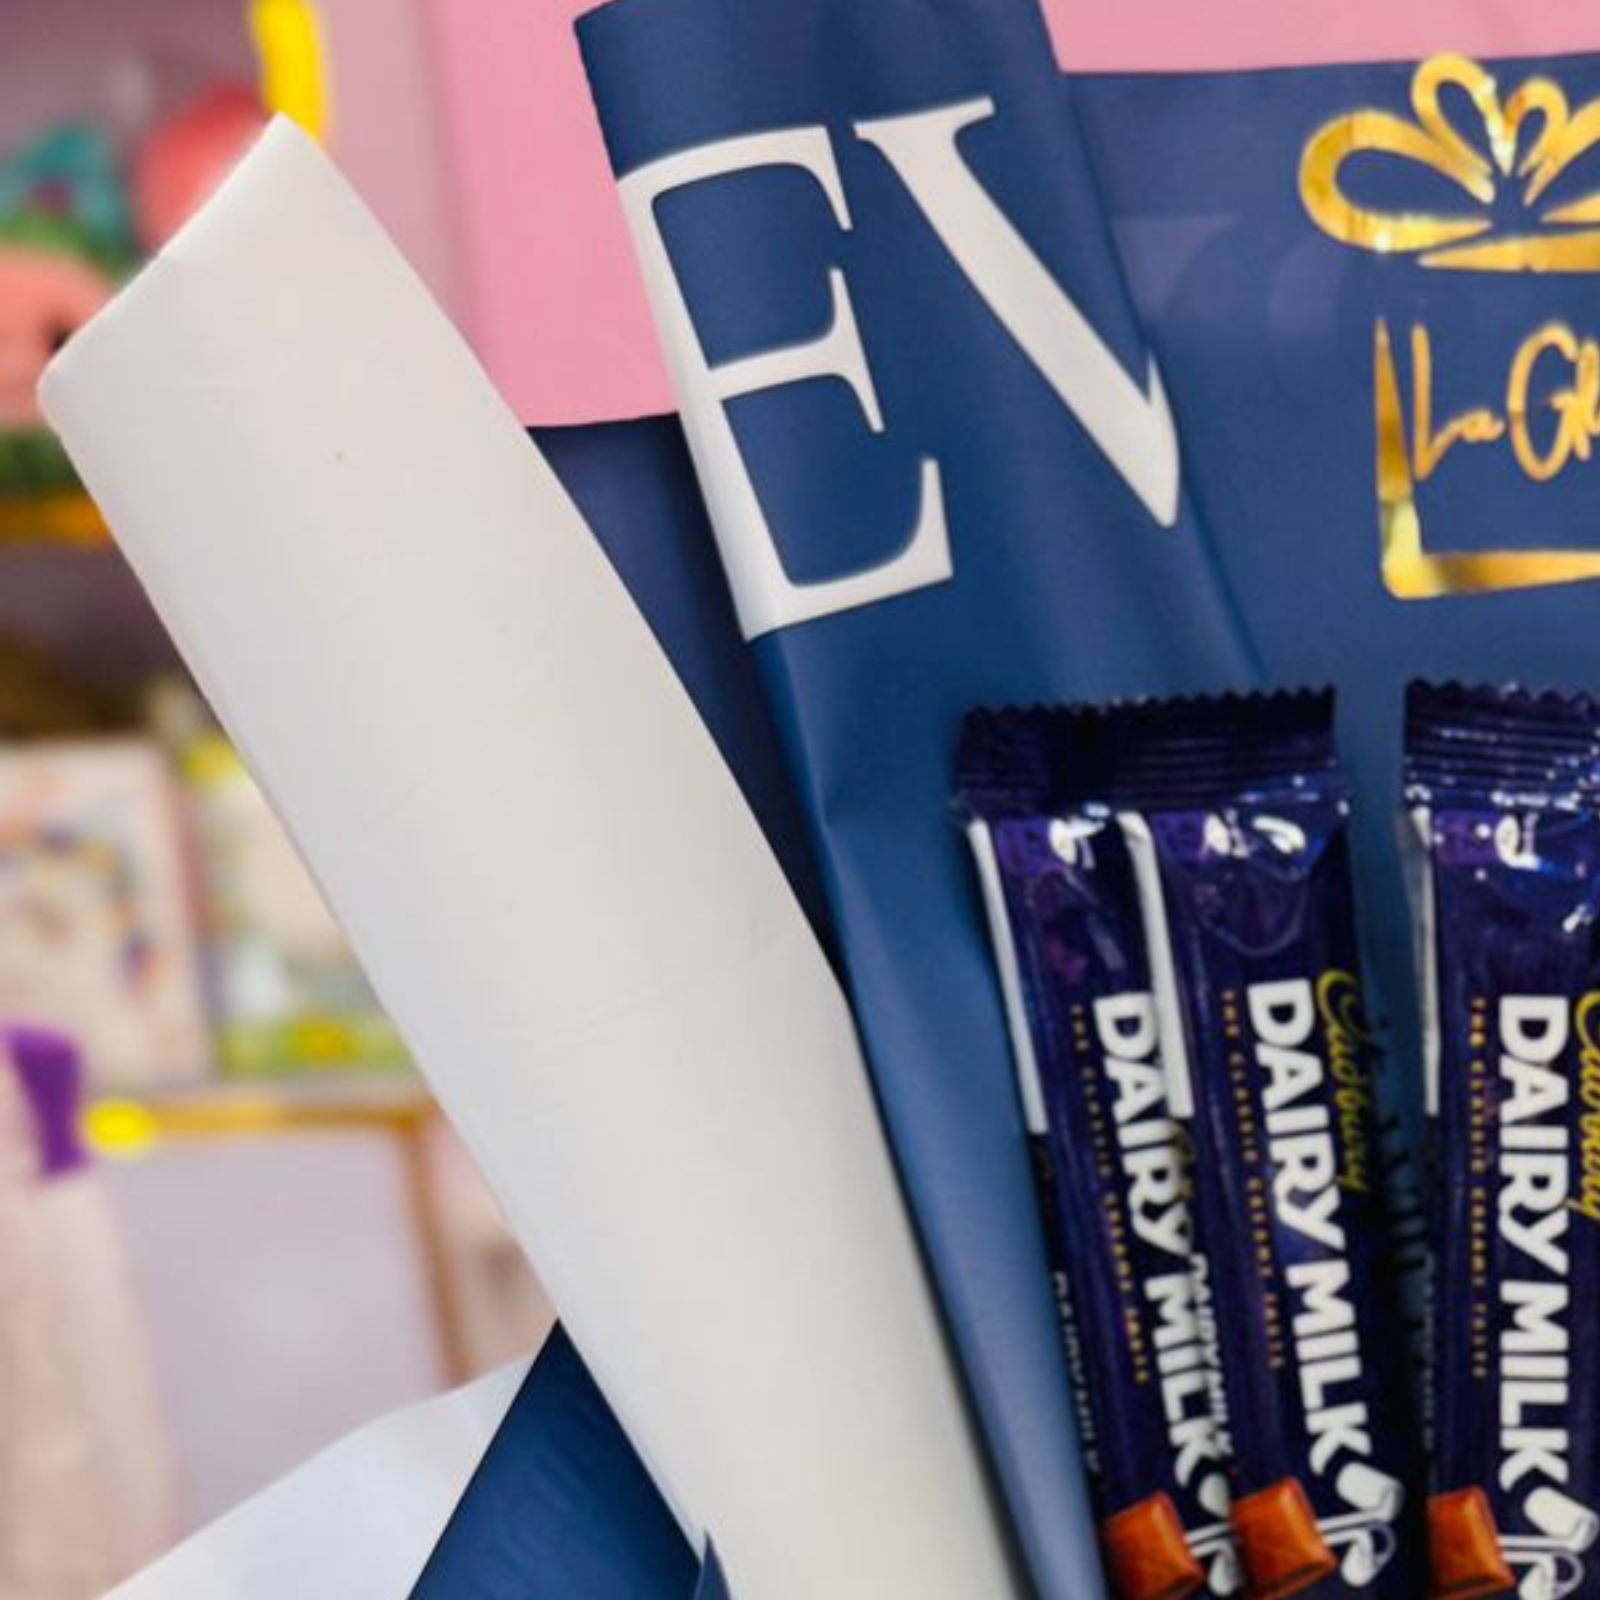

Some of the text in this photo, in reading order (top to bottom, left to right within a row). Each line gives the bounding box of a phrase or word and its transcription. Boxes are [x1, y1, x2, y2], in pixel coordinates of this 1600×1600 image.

[1093, 990, 1198, 1256] DAIRY
[1246, 979, 1347, 1251] DAIRY
[1496, 995, 1570, 1492] DAIRY MILK
[1143, 1272, 1224, 1488] MILK
[1285, 1258, 1373, 1476] MILK
